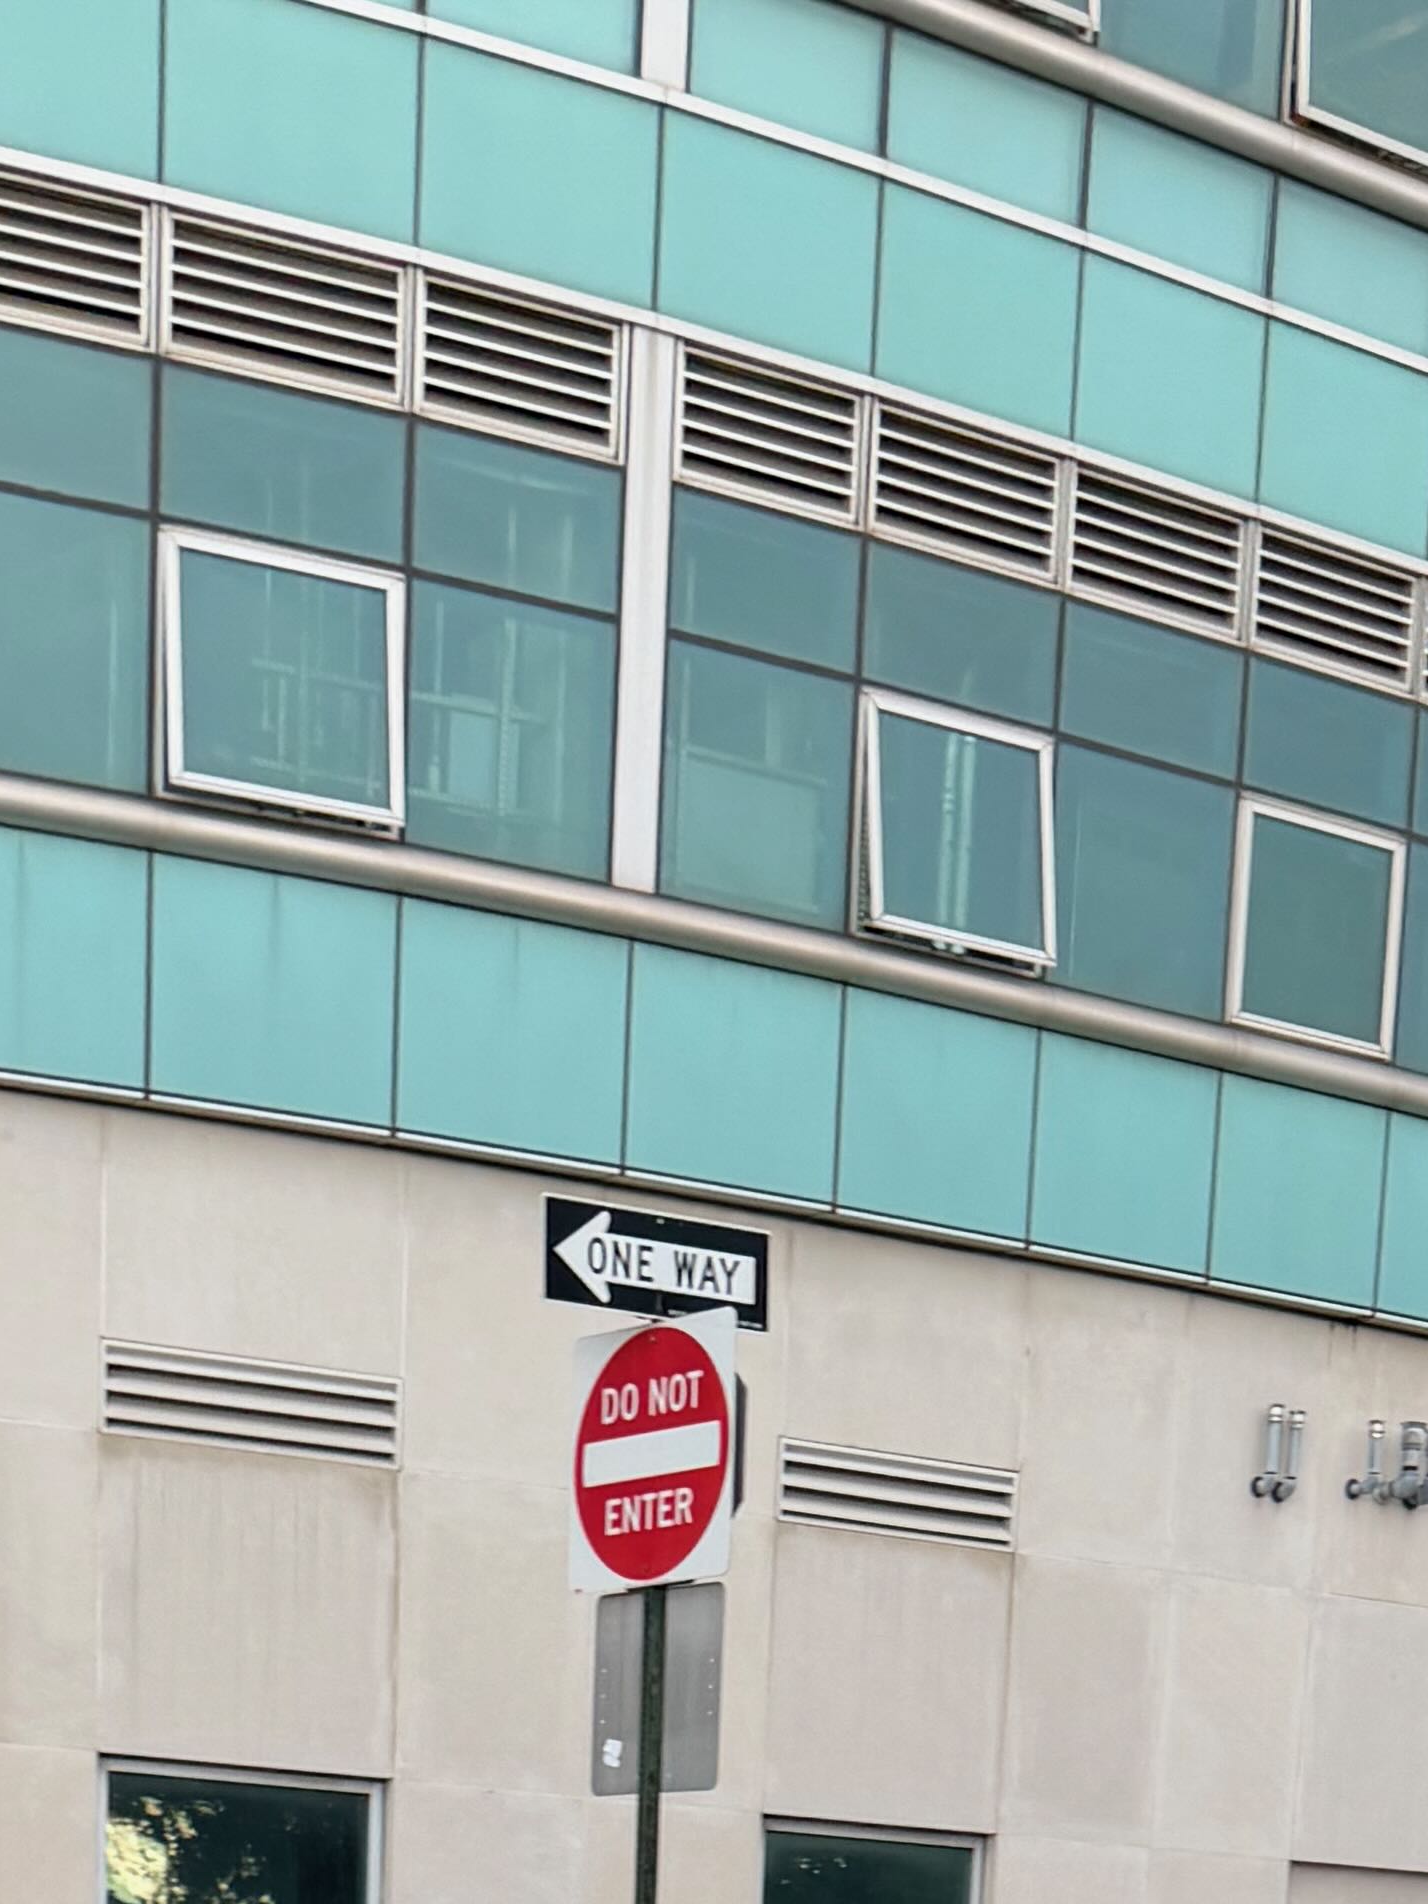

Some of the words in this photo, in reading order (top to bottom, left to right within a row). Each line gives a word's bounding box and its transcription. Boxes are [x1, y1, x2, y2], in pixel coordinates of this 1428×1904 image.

[587, 1236, 655, 1283] ONE
[674, 1250, 741, 1296] WAY
[600, 1382, 640, 1425] DO
[647, 1369, 705, 1417] NOT
[603, 1486, 695, 1537] ENTER
